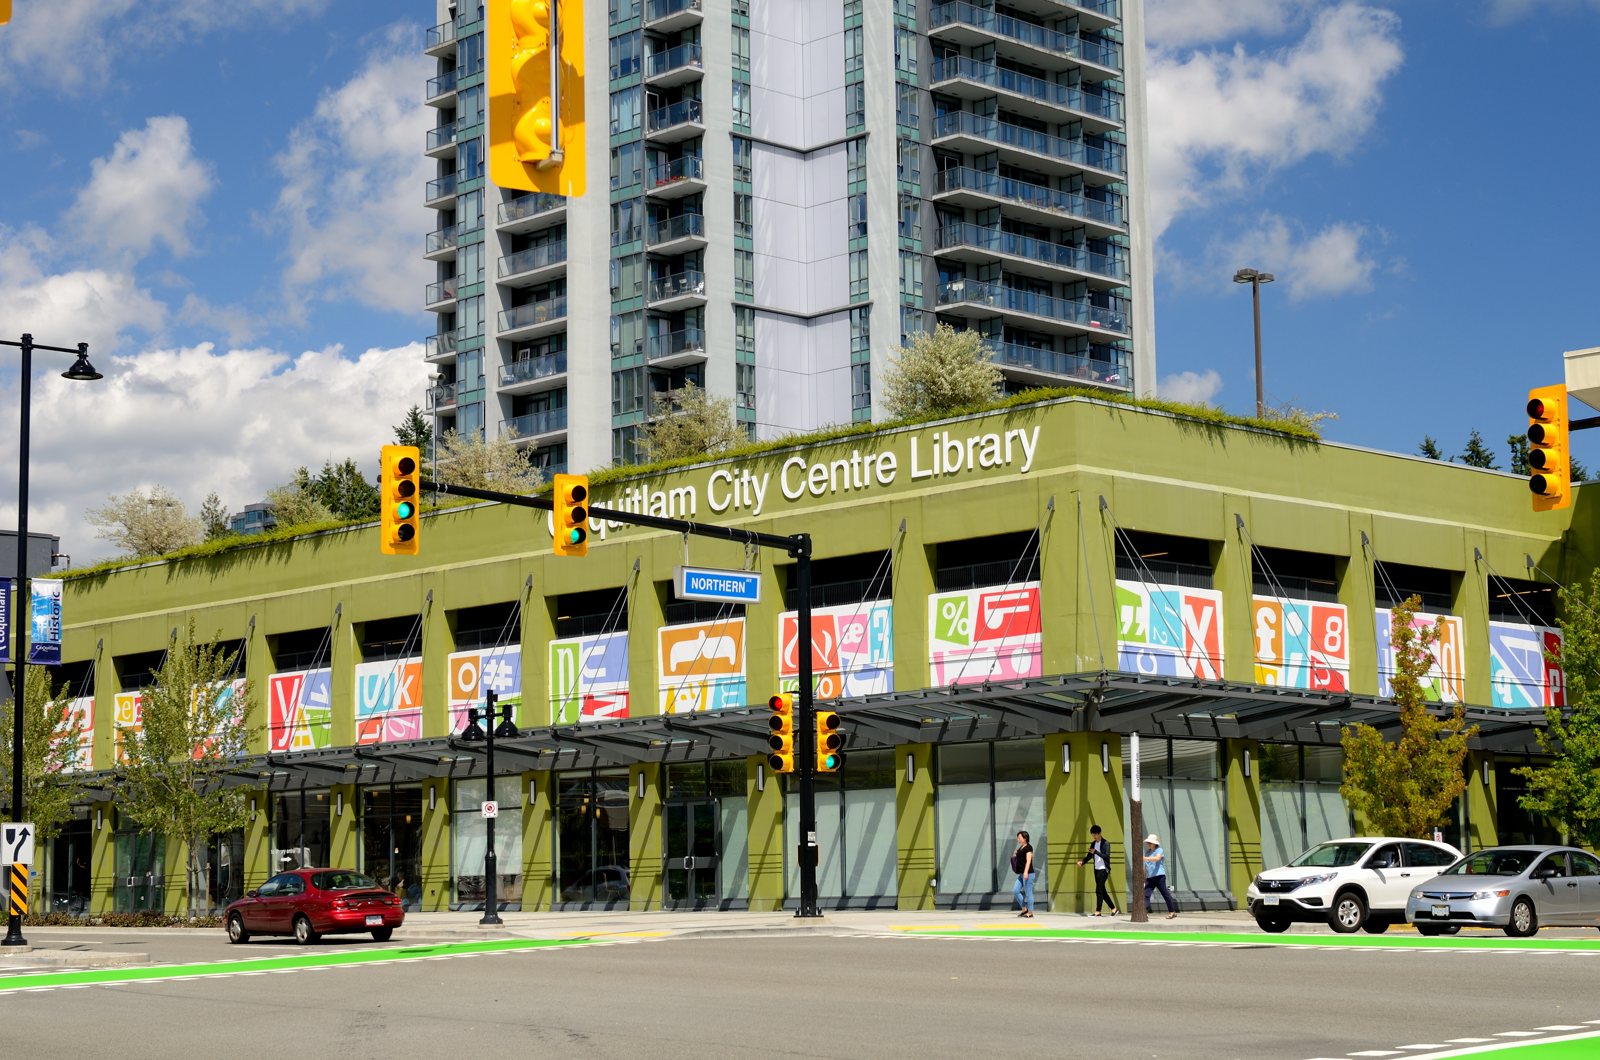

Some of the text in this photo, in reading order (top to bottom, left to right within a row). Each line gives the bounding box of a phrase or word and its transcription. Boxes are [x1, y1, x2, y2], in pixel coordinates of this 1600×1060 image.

[548, 426, 1041, 540] quitlam City Centre Library
[691, 577, 746, 593] NORTHERN
[50, 591, 60, 642] Historic
